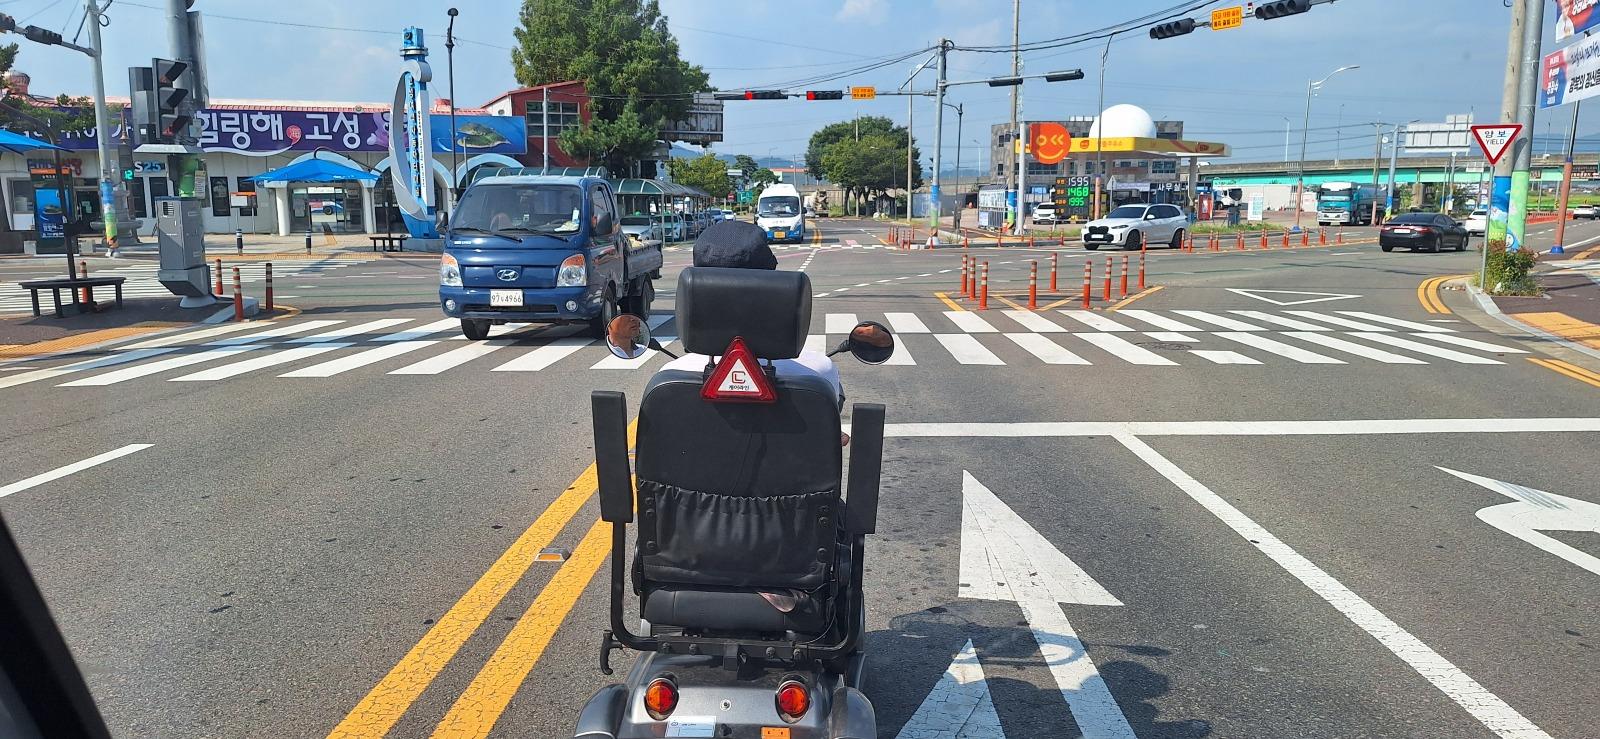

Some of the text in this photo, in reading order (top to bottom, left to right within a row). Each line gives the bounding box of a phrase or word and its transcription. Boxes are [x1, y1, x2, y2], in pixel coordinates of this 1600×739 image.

[196, 111, 361, 150] 힐링해 고성
[1068, 176, 1089, 186] 1595
